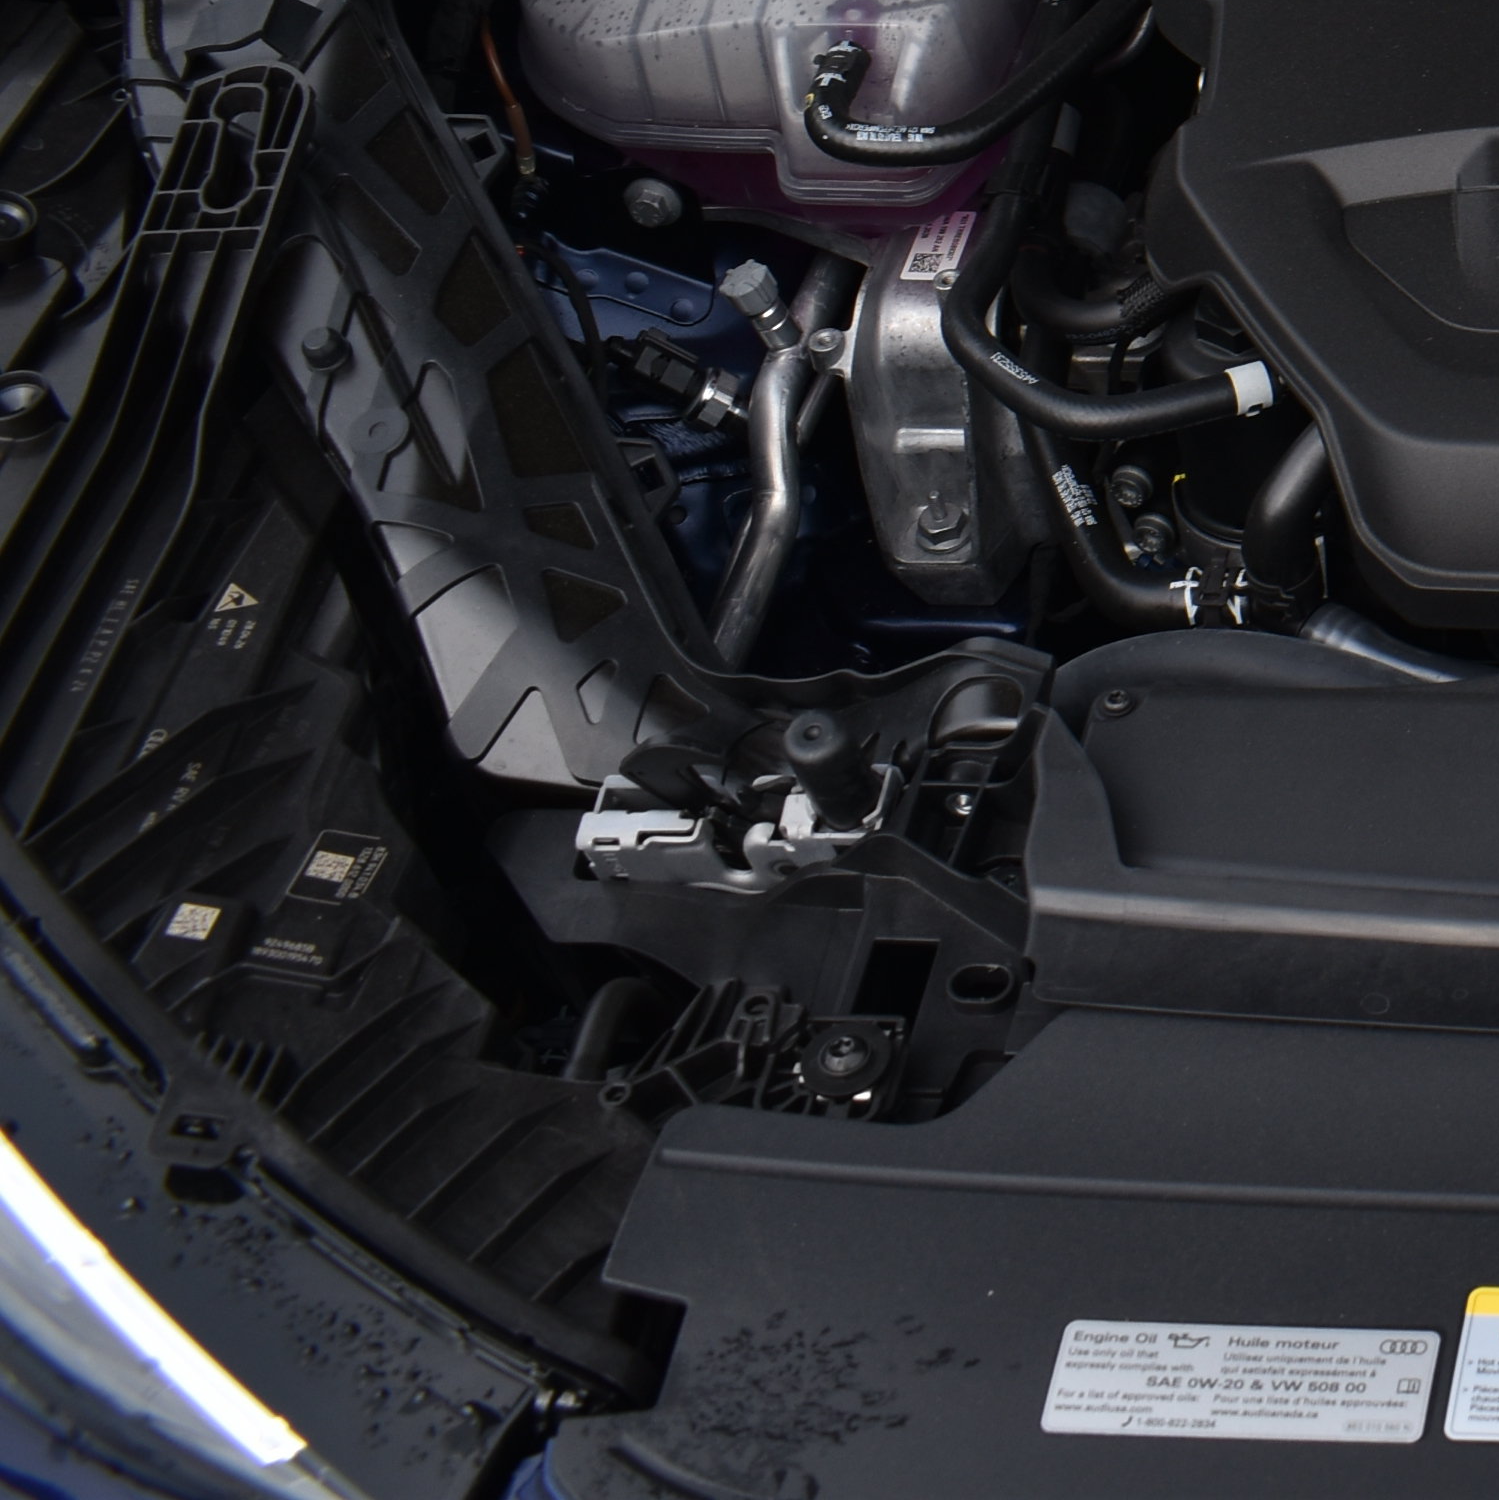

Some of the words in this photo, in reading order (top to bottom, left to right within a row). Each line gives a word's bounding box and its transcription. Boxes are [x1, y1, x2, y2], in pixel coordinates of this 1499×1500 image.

[1073, 1330, 1130, 1345] Engine
[1135, 1332, 1158, 1344] Oil
[1227, 1336, 1270, 1349] Huile
[1275, 1339, 1340, 1351] moteur
[1067, 1347, 1090, 1357] Use
[1092, 1348, 1117, 1359] only
[1119, 1349, 1135, 1358] oil
[1136, 1349, 1159, 1359] that
[1223, 1351, 1264, 1363] Utilisez
[1266, 1354, 1333, 1365] uniquement
[1335, 1354, 1350, 1365] de
[1065, 1360, 1116, 1372] expressly
[1119, 1361, 1167, 1373] complies
[1170, 1362, 1195, 1372] with
[1477, 1358, 1495, 1367] Hot
[1145, 1375, 1182, 1388] SAE
[1187, 1377, 1244, 1390] 0W-20
[1249, 1379, 1264, 1391] &
[1271, 1380, 1303, 1392] VW
[1307, 1381, 1340, 1393] 508
[1344, 1381, 1367, 1394] 00
[1056, 1388, 1075, 1398] For
[1077, 1391, 1084, 1399] a
[1086, 1389, 1105, 1399] list
[1106, 1390, 1119, 1400] of
[1121, 1391, 1174, 1402] approved
[1213, 1394, 1240, 1404] Pour
